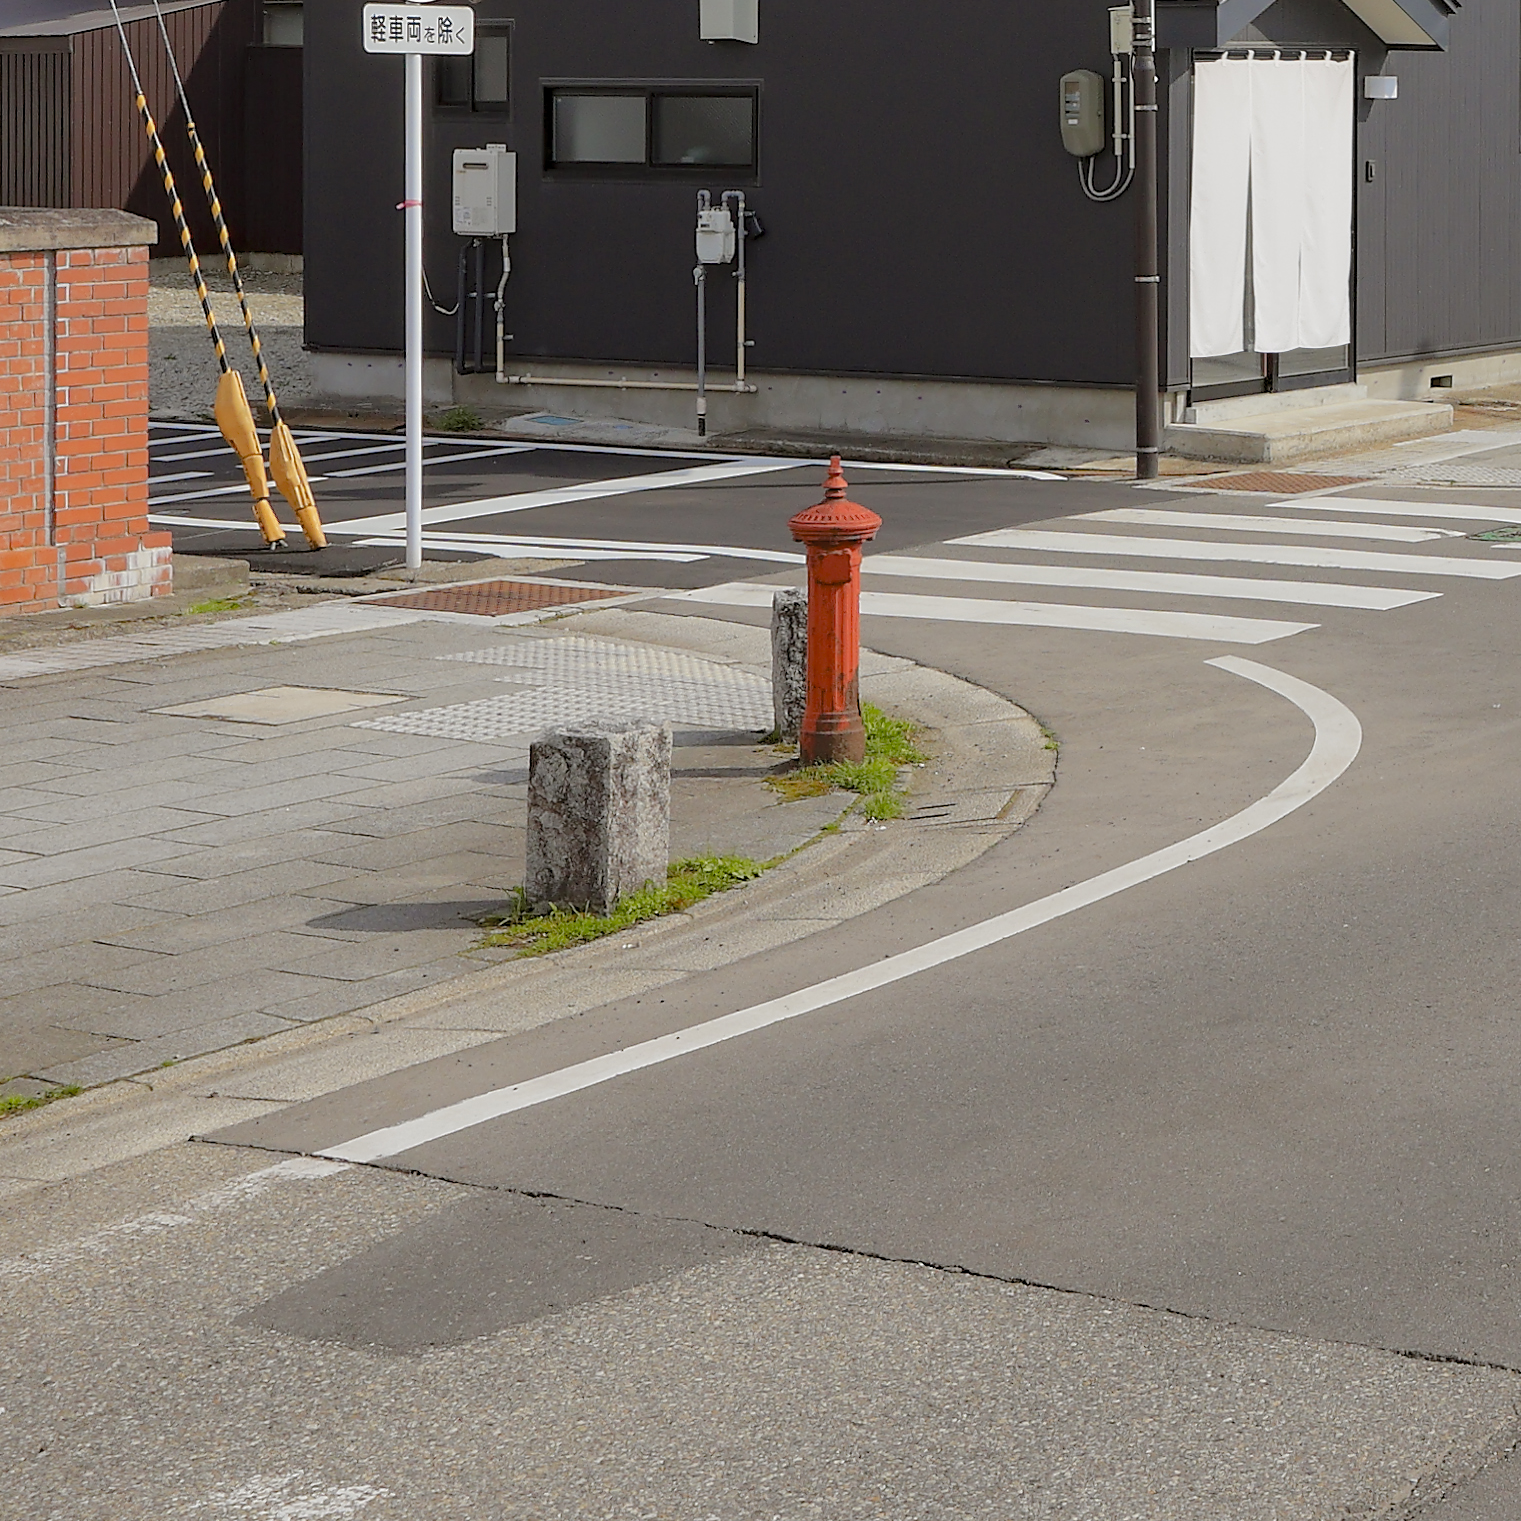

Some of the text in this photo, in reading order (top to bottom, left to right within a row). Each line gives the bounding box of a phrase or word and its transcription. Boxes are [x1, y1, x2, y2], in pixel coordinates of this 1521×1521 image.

[370, 13, 465, 45] 軽車両を除く
